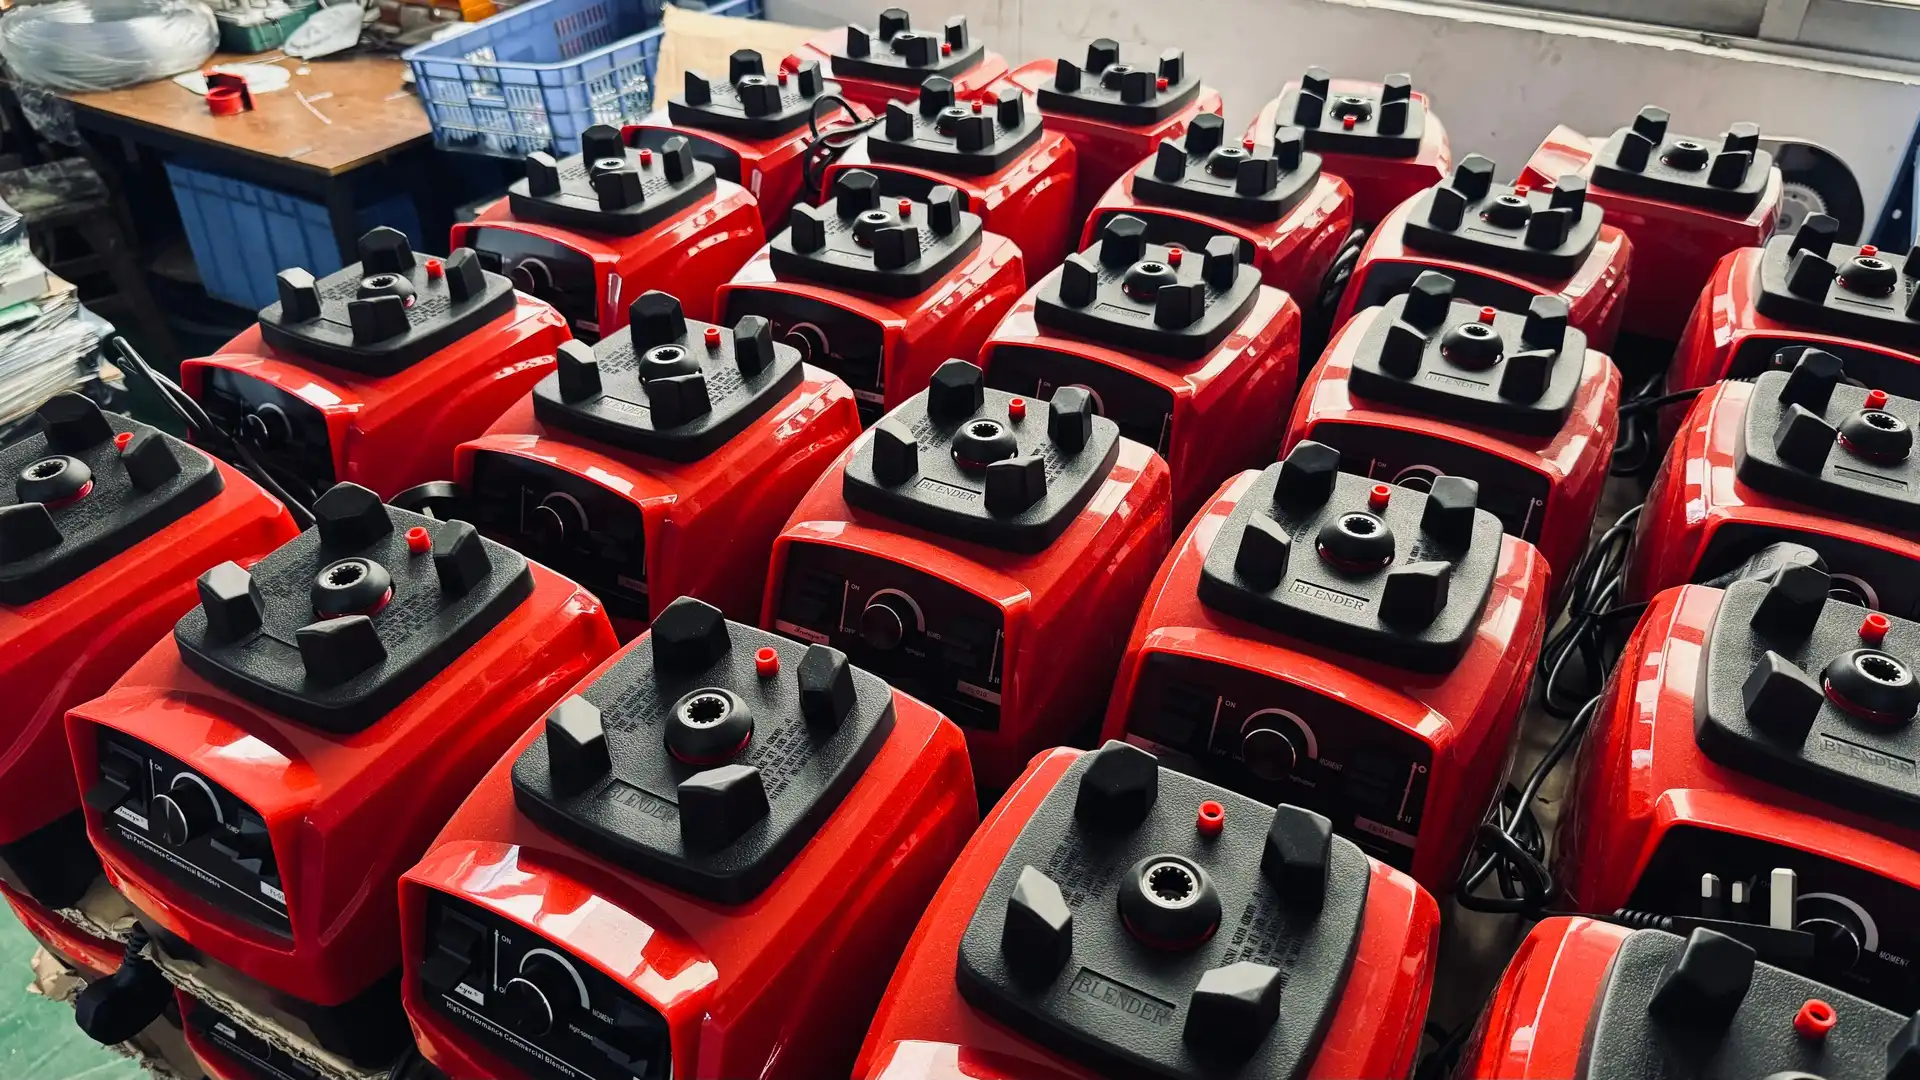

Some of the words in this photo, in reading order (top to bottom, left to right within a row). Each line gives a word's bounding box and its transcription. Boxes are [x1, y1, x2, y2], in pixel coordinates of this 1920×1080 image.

[919, 481, 977, 501] BLENDER
[1294, 584, 1364, 611] BLENDER
[1225, 700, 1236, 709] ON
[1824, 740, 1912, 776] BLENDER
[607, 786, 678, 822] BLENDER
[121, 830, 134, 842] High
[133, 835, 166, 859] Performance
[165, 852, 197, 876] Commercial
[196, 870, 221, 889] Blenders
[501, 935, 512, 945] ON
[1878, 950, 1910, 967] MOMENT
[1075, 975, 1171, 1027] BLENDER
[592, 1008, 614, 1025] MOMENT
[446, 1001, 461, 1014] High
[461, 1010, 503, 1038] Performance
[503, 1033, 544, 1060] Commercial
[544, 1055, 576, 1078] Blenders
